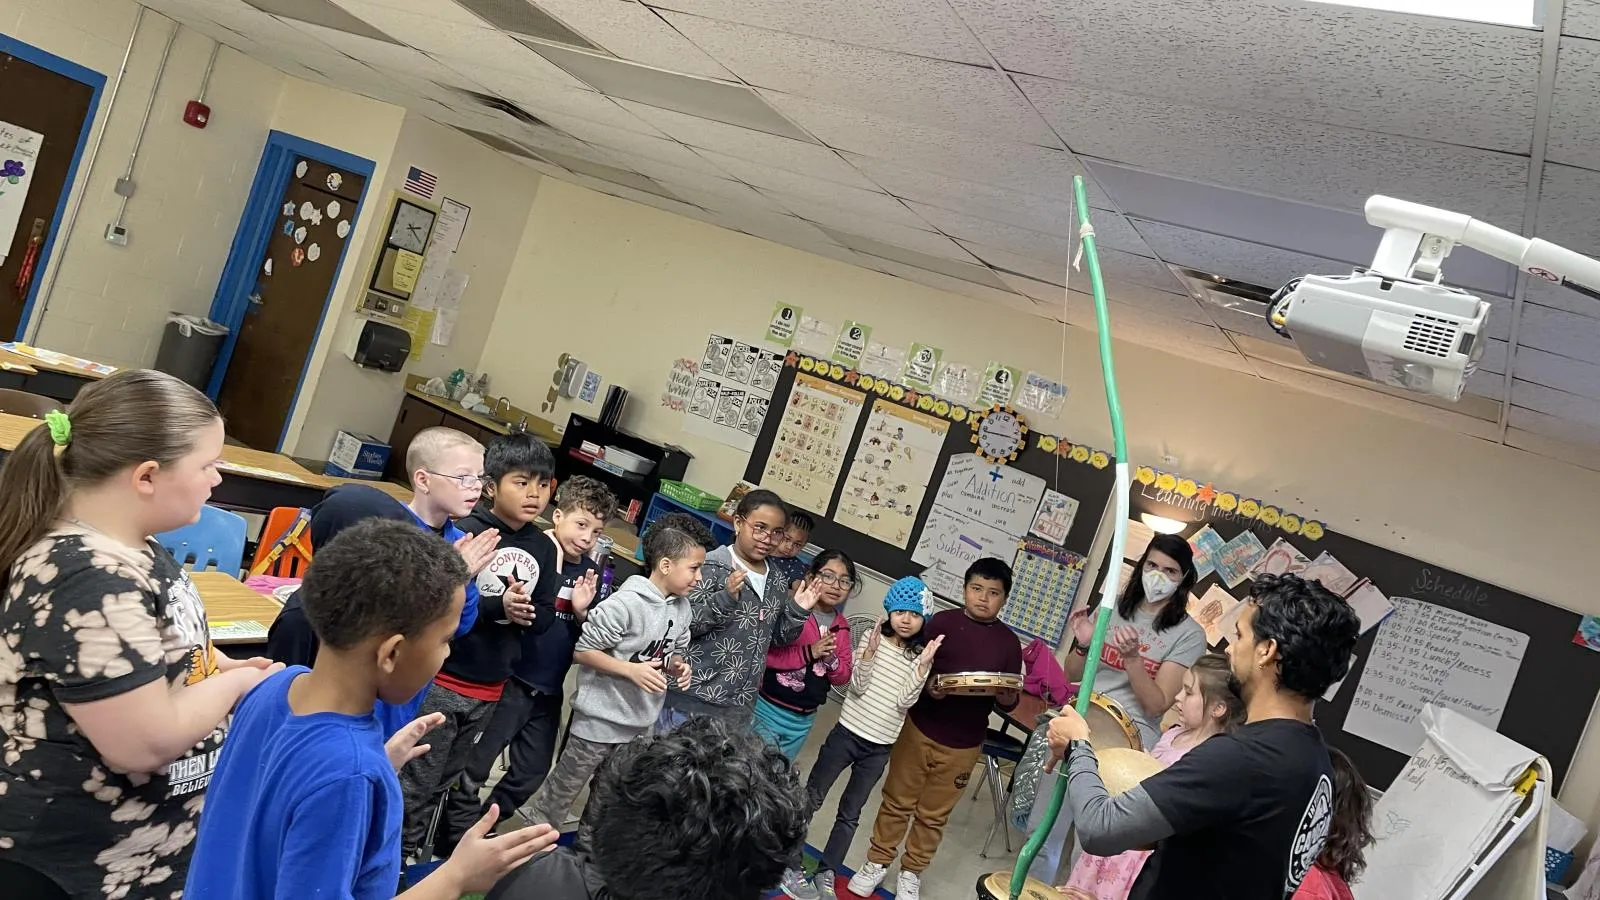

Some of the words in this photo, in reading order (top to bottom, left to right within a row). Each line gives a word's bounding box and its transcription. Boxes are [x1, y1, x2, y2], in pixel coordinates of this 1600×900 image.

[672, 372, 691, 386] Hello
[964, 474, 1016, 508] Addition
[1011, 478, 1026, 487] add
[991, 503, 1016, 514] increase
[1141, 484, 1208, 521] Learning
[490, 552, 536, 579] CONVERSE
[1415, 568, 1488, 602] Schedule
[1425, 641, 1461, 660] Reading
[1421, 664, 1450, 680] Math
[168, 754, 207, 781] THEN
[172, 775, 212, 796] BELIEV
